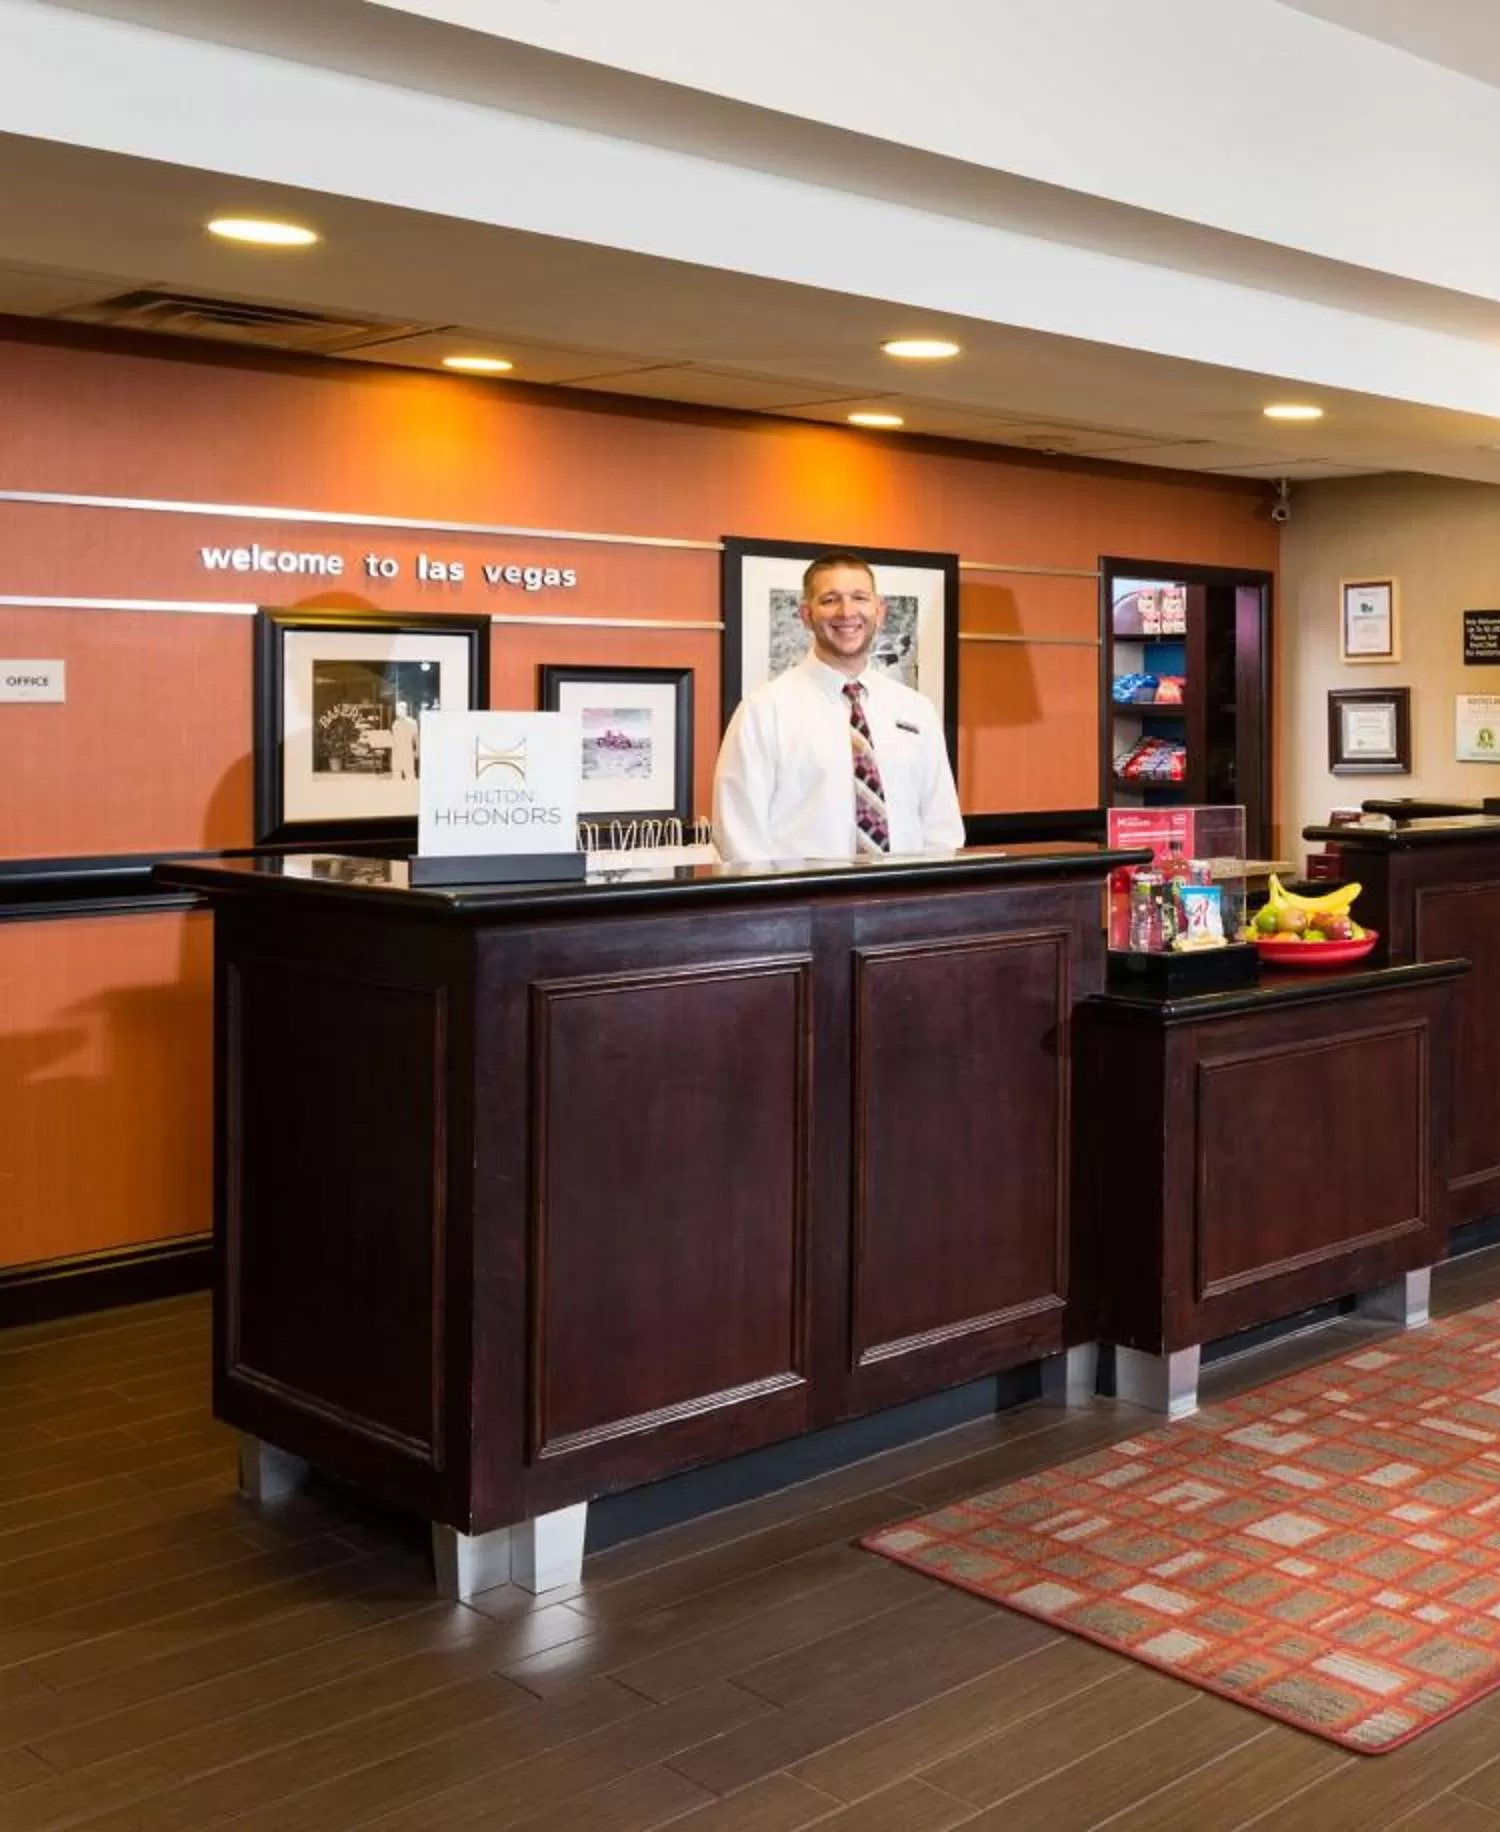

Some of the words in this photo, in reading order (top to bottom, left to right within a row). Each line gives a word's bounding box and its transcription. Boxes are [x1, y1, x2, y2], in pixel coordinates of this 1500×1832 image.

[201, 545, 345, 576] welcome
[366, 553, 399, 578] to
[418, 553, 465, 581] las
[484, 563, 577, 591] vegas
[5, 675, 49, 687] OFFICE
[465, 789, 535, 804] HILTON
[434, 807, 562, 827] HHONORS
